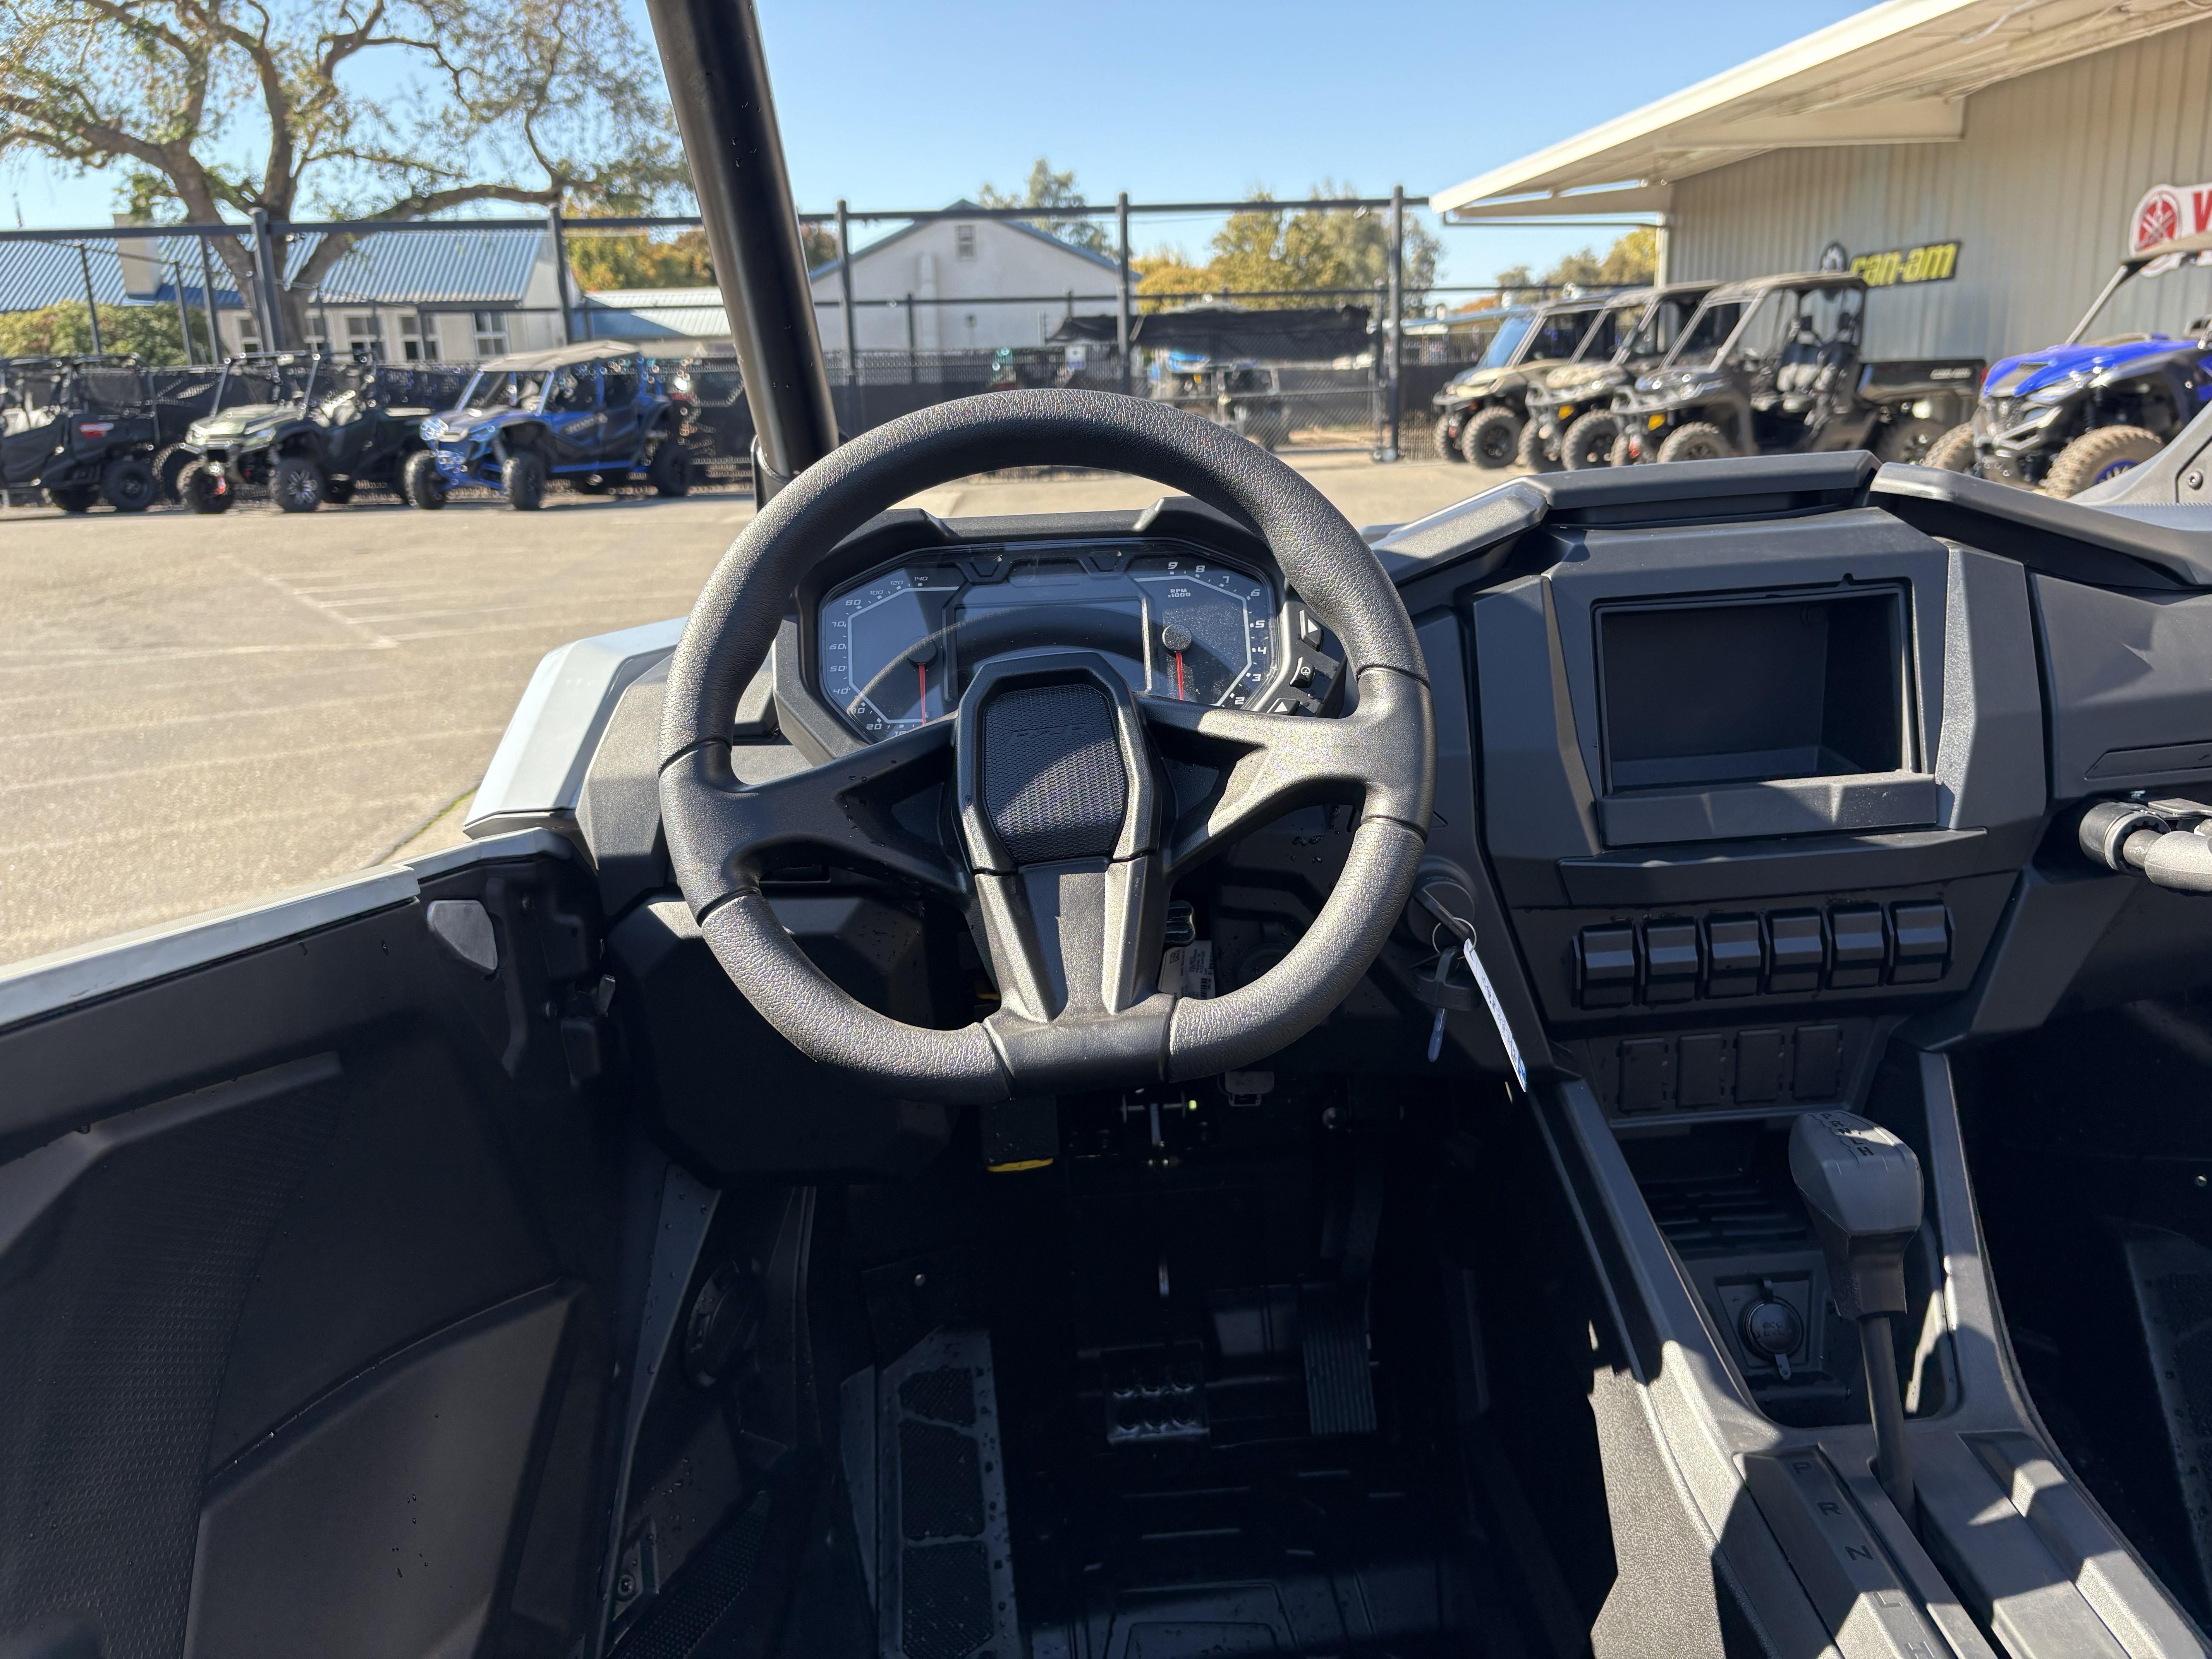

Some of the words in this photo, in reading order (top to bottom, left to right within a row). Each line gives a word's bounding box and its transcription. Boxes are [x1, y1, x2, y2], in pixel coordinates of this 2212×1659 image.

[1850, 243, 1955, 286] can-am
[1168, 562, 1178, 570] 9
[1255, 620, 1265, 628] 5
[1257, 646, 1267, 654] 4
[1252, 673, 1261, 682] 3
[1234, 696, 1245, 705] 2
[1857, 1146, 1874, 1156] H
[1792, 1461, 1811, 1475] P
[1818, 1501, 1842, 1516] R
[1844, 1545, 1873, 1561] N
[1873, 1591, 1902, 1608] L
[1903, 1641, 1935, 1659] H
